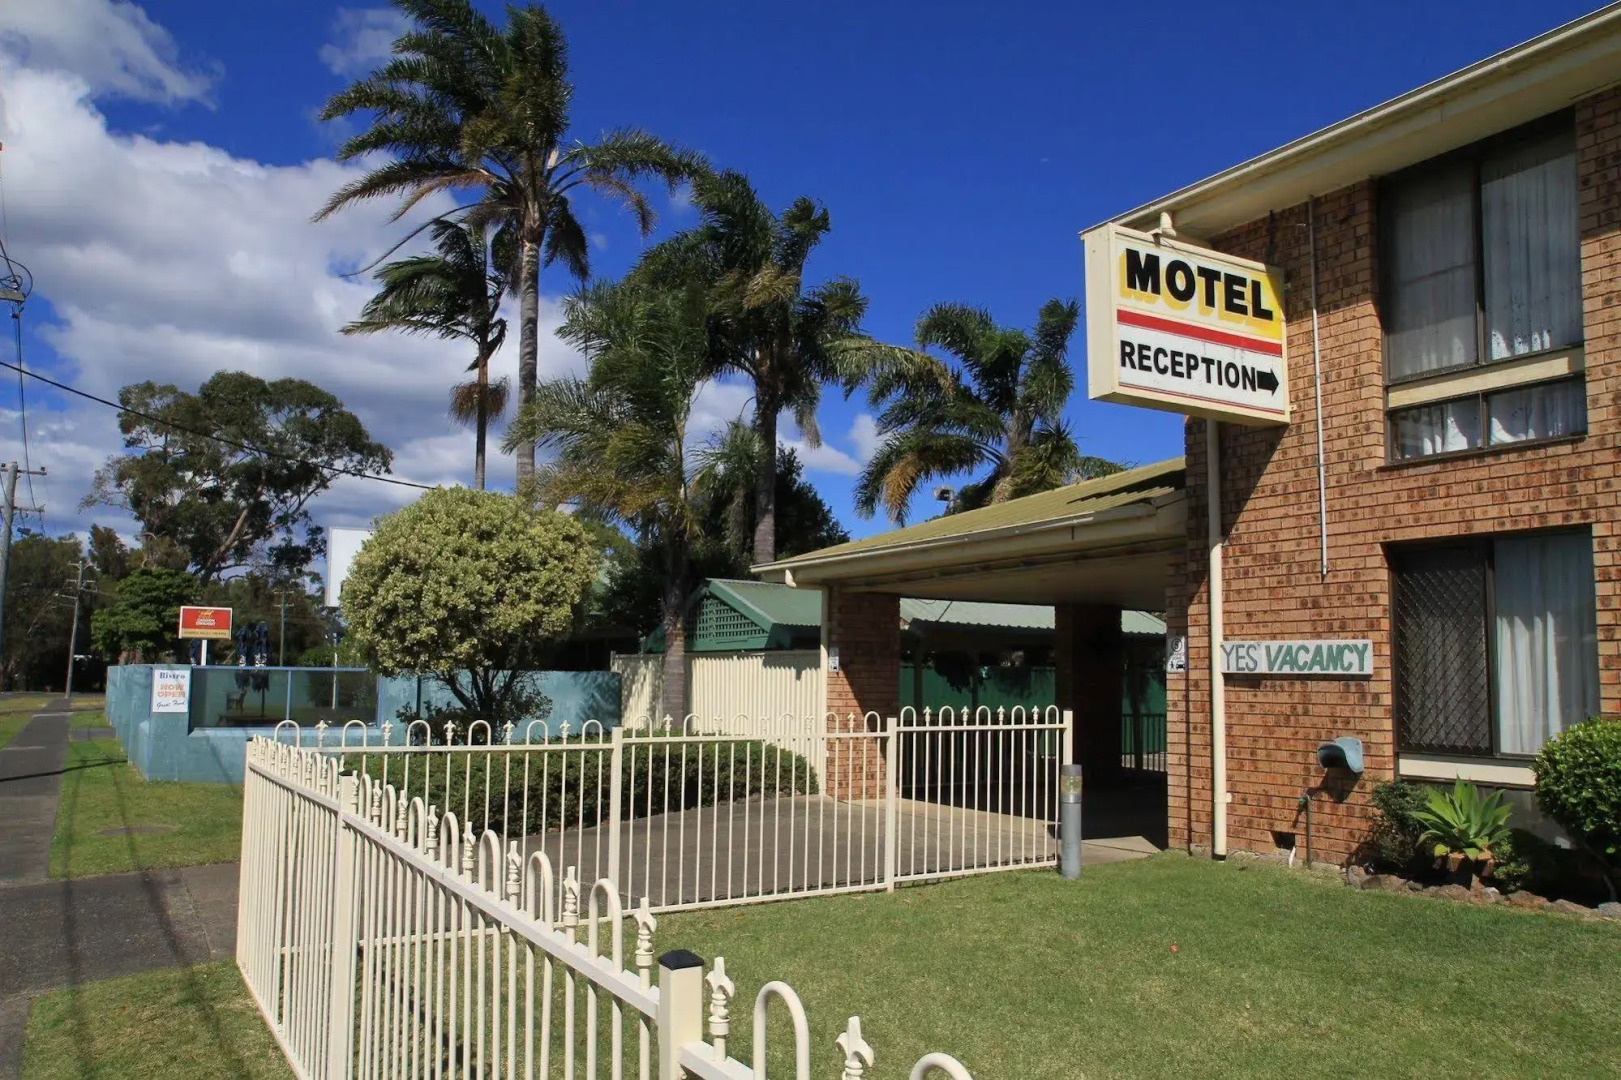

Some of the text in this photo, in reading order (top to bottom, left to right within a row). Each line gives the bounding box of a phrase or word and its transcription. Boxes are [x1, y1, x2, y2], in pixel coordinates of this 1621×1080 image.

[1125, 248, 1274, 321] MOTEL
[1120, 340, 1257, 392] RECEPTION
[1220, 643, 1369, 672] YES VACANCY
[157, 690, 186, 698] OPEN
[160, 683, 185, 691] NOW
